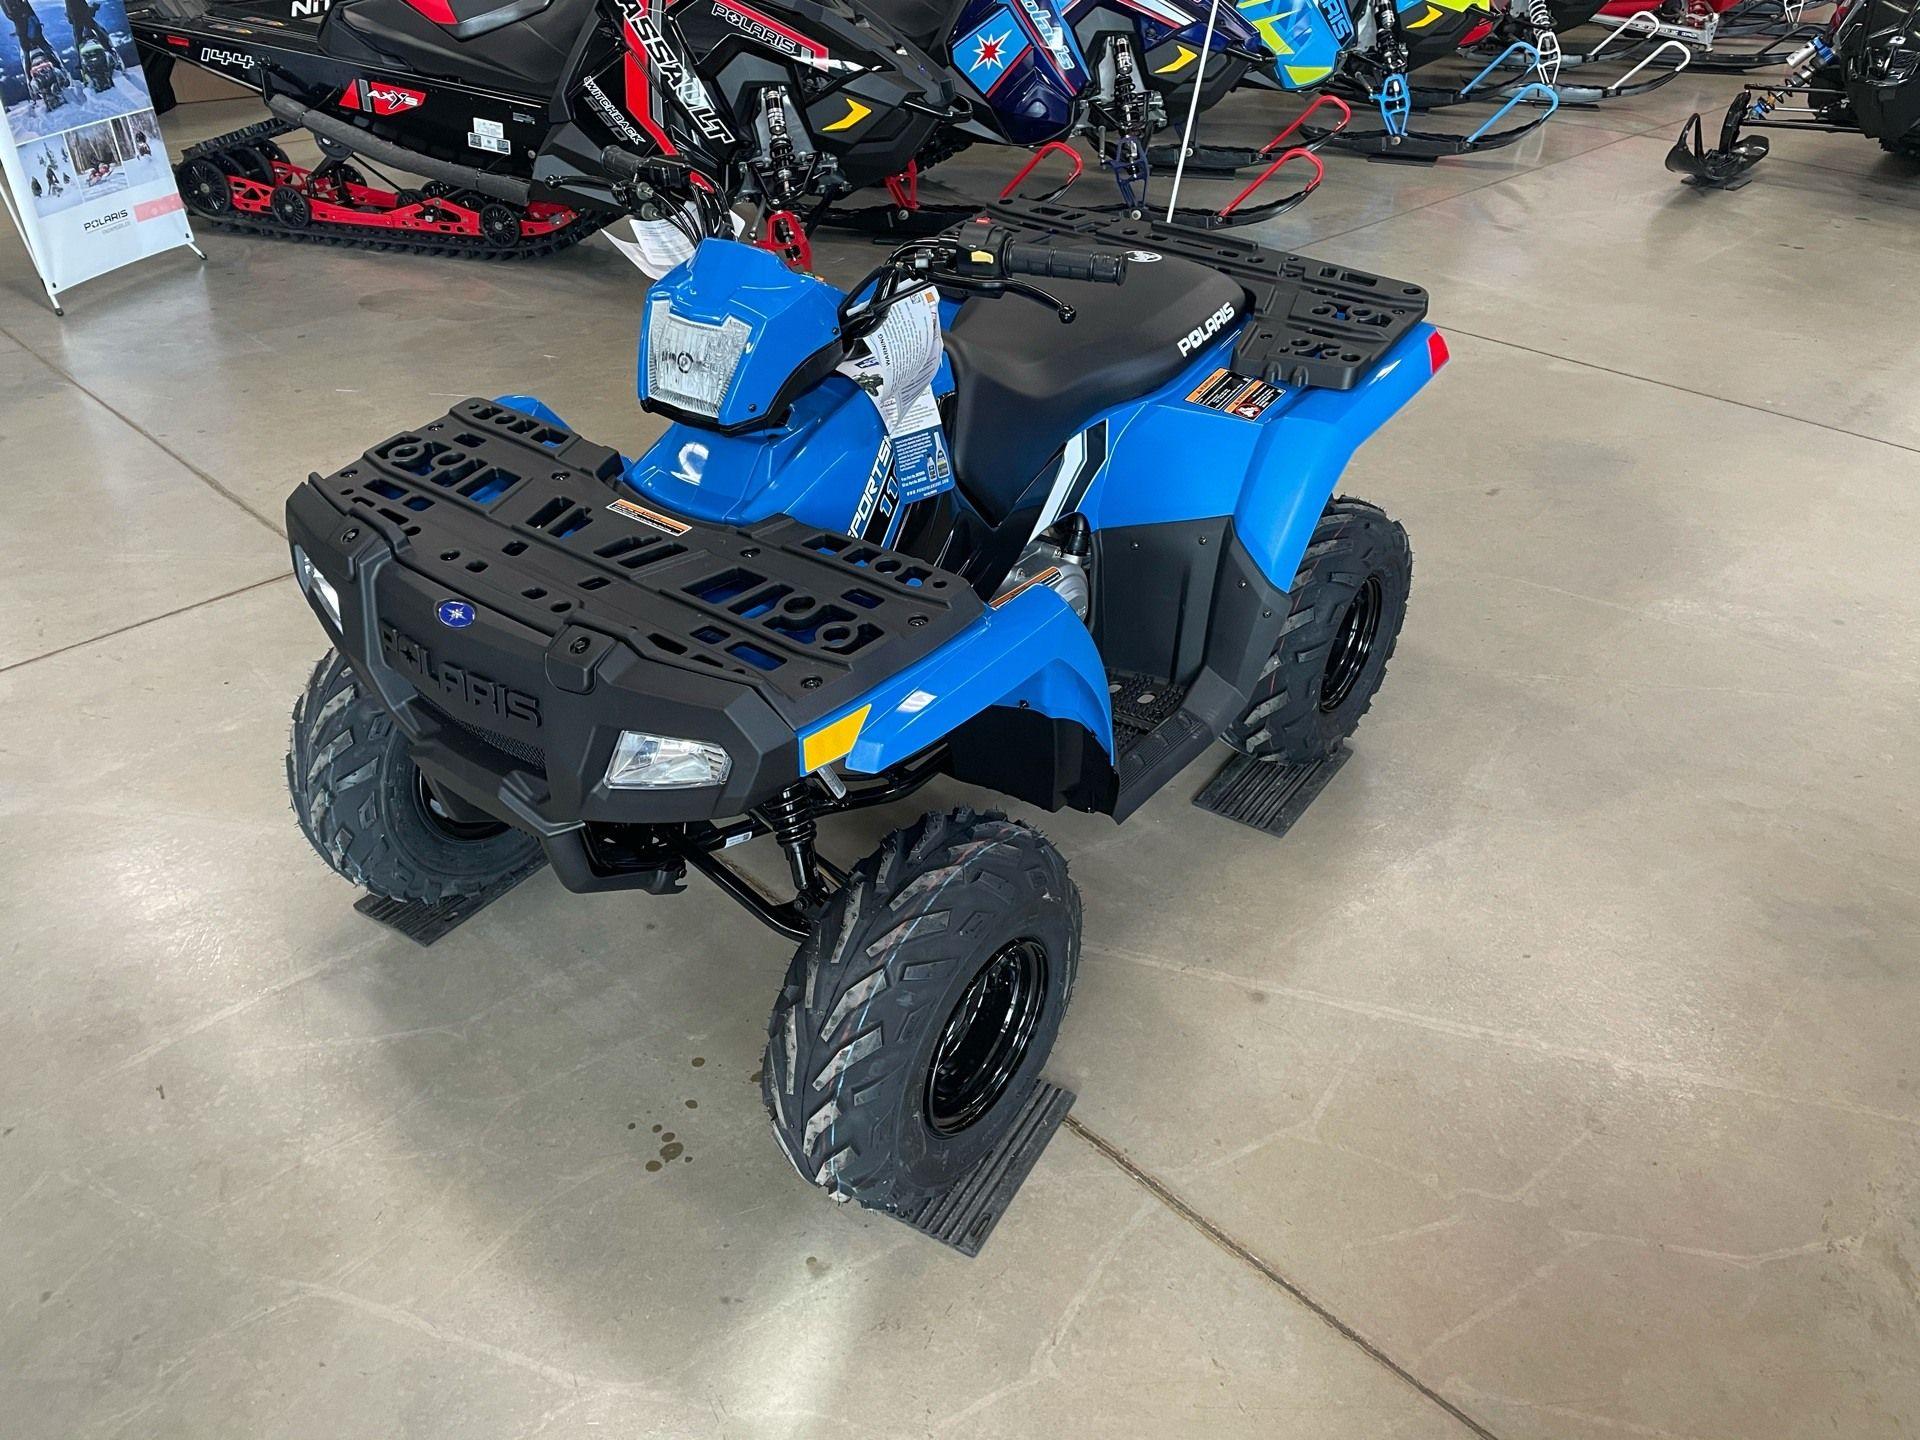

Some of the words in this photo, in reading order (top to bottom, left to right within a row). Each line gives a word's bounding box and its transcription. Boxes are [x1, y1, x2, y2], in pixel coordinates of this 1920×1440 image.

[711, 2, 797, 55] POLARIS
[200, 47, 255, 70] 144
[614, 0, 737, 145] ASSAULT
[366, 90, 419, 110] AXYS
[583, 75, 646, 145] SWITCHBACK
[83, 209, 129, 231] POLARIS
[877, 333, 891, 367] WARNING
[1176, 302, 1235, 357] POLARIS
[847, 435, 893, 540] PORTS
[880, 463, 899, 518] 11
[379, 619, 543, 729] POLARIS
